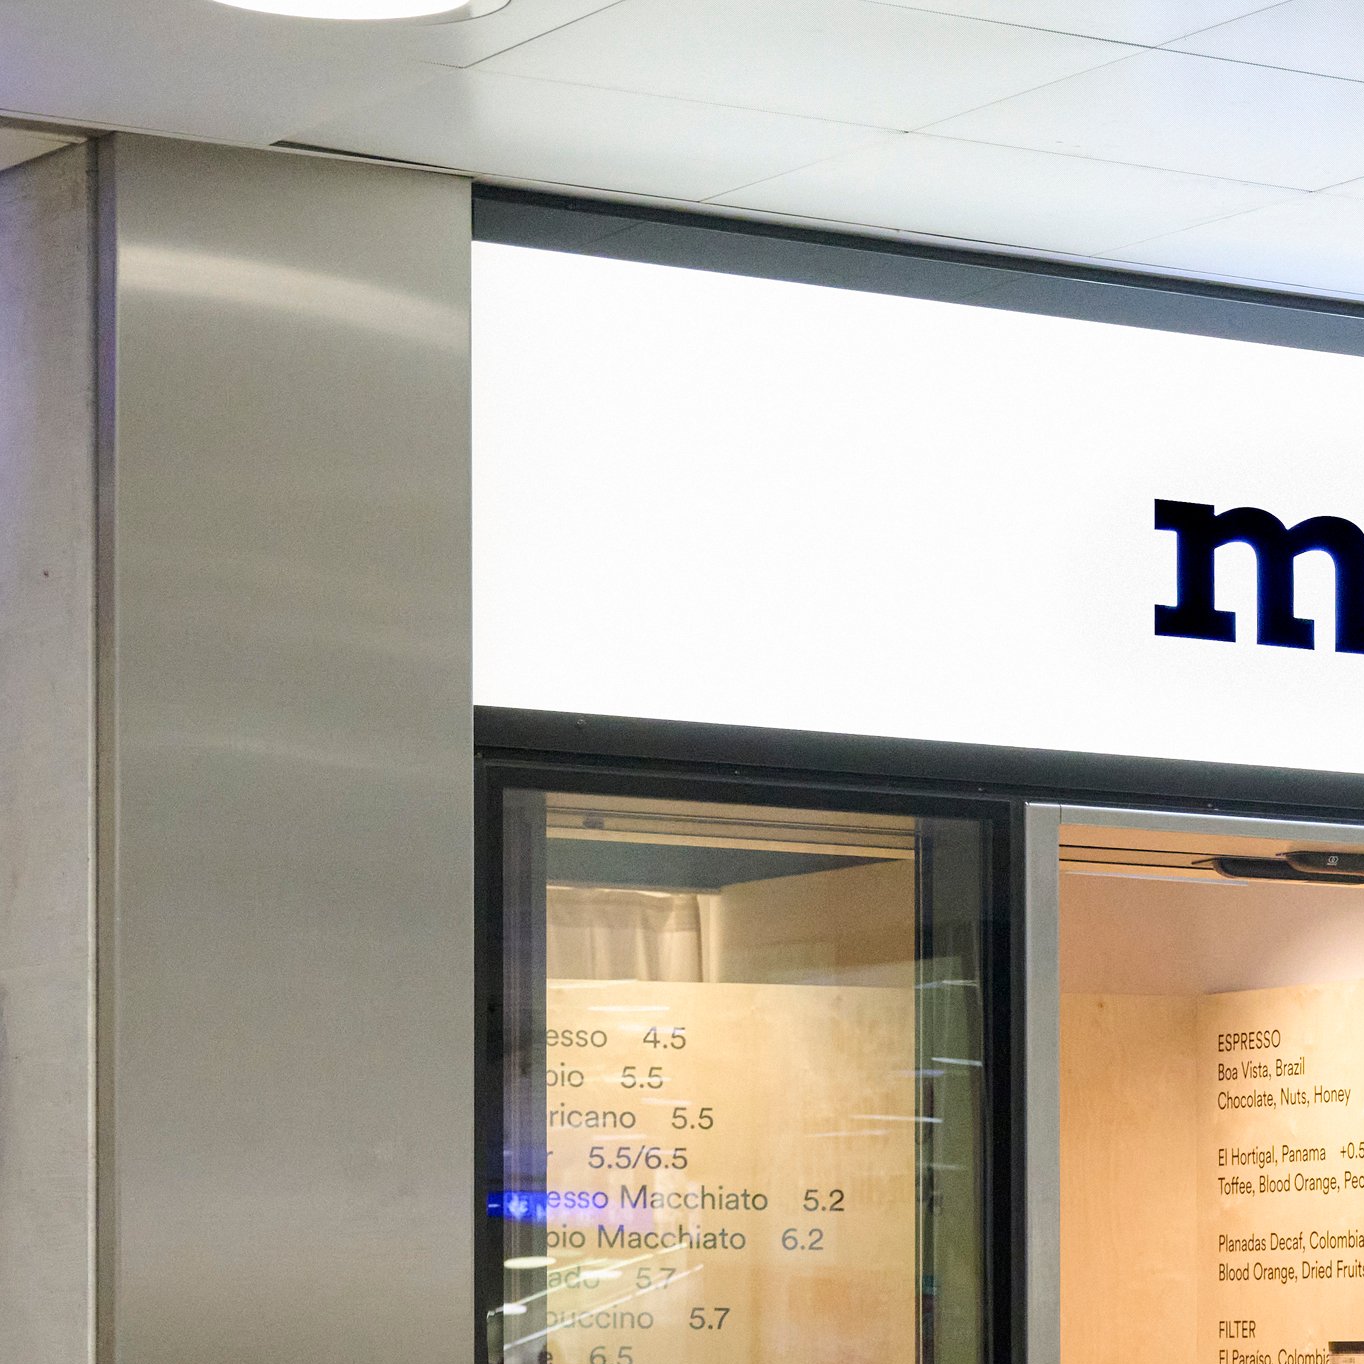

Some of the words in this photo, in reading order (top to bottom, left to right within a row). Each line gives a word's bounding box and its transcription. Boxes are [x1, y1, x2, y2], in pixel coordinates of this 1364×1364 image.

[643, 1026, 687, 1050] 4.5
[1218, 1029, 1281, 1052] ESPRESSO
[621, 1066, 664, 1089] 5.5
[1218, 1063, 1238, 1081] Boa
[1241, 1060, 1272, 1080] Vista,
[1276, 1057, 1305, 1077] Brazil
[1218, 1089, 1277, 1110] Chocolate,
[1281, 1088, 1309, 1107] Nuts,
[1314, 1085, 1351, 1106] Honey
[672, 1107, 713, 1130] 5.5
[588, 1145, 688, 1170] 5.5/6.5
[1218, 1148, 1228, 1166] El
[1231, 1146, 1278, 1168] Hortigal,
[1282, 1144, 1326, 1162] Panama
[1218, 1176, 1255, 1197] Toffee,
[1259, 1174, 1290, 1193] Blood
[1294, 1173, 1340, 1194] Orange,
[621, 1185, 768, 1211] Macchiato
[803, 1189, 845, 1212] 5.2
[598, 1224, 746, 1250] Macchiato
[781, 1228, 824, 1252] 6.2
[1218, 1234, 1266, 1252] Planadas
[1270, 1232, 1306, 1253] Decaf,
[1309, 1230, 1364, 1250] Colombia
[636, 1267, 676, 1290] 5.7
[1218, 1263, 1249, 1281] Blood
[1253, 1262, 1298, 1284] Orange,
[1302, 1260, 1332, 1280] Dried
[689, 1307, 730, 1330] 5.7
[1218, 1321, 1256, 1339] FILTER
